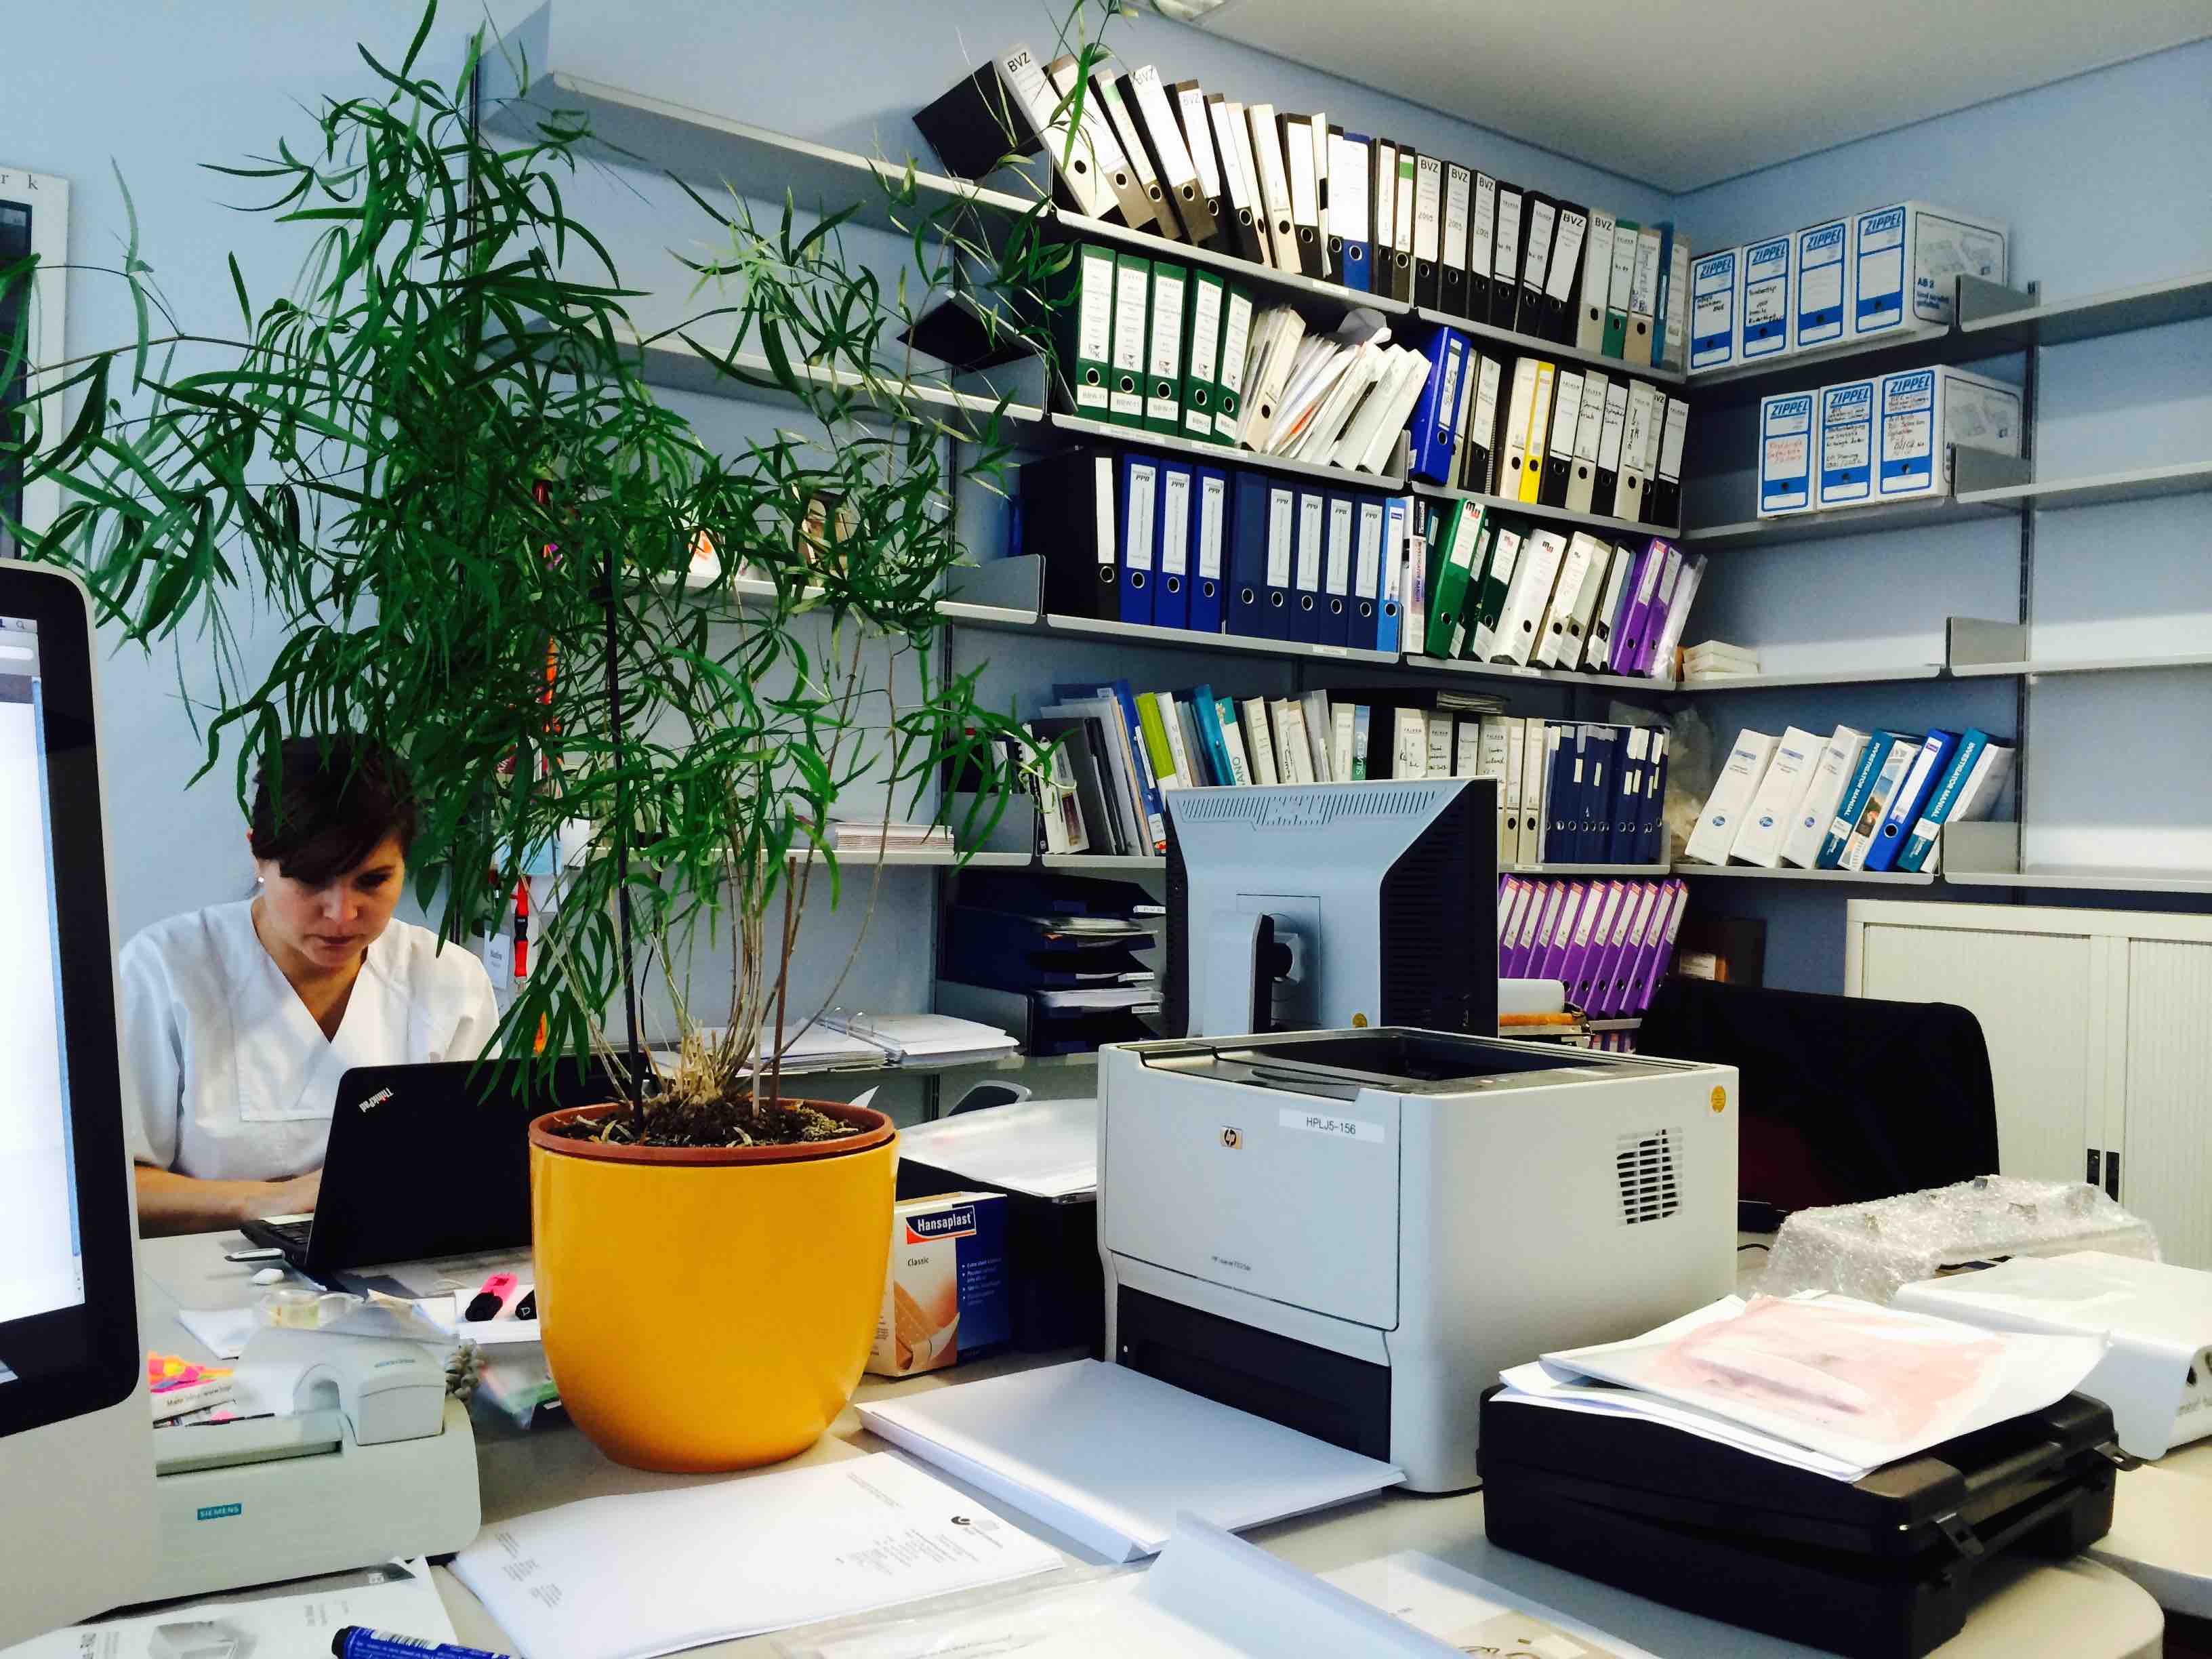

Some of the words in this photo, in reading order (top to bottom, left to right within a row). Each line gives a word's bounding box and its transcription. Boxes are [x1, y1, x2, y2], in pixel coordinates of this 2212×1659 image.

[1007, 52, 1031, 72] BVZ
[1420, 159, 1438, 173] BVZ
[1452, 168, 1468, 183] BVZ
[1479, 177, 1494, 191] BVZ
[1563, 213, 1584, 227] BVZ
[1595, 217, 1612, 231] BVZ
[1865, 213, 1902, 233] ZIPPEL
[1807, 229, 1842, 249] ZIPPEL
[1754, 243, 1786, 264] ZIPPEL
[1701, 259, 1732, 279] ZIPPEL
[1889, 375, 1929, 394] ZIPPEL
[1831, 387, 1869, 406] ZIPPEL
[1770, 401, 1809, 418] ZIPPEL
[1948, 741, 1976, 789] INVESTIGATOR
[1931, 787, 1952, 818] MANUAL
[359, 1087, 394, 1113] ThinkPad
[1306, 1116, 1356, 1135] HPLJ5-156
[918, 1212, 972, 1233] Hansaplast
[907, 1257, 929, 1267] Classic
[199, 1505, 241, 1519] SIEMENS
